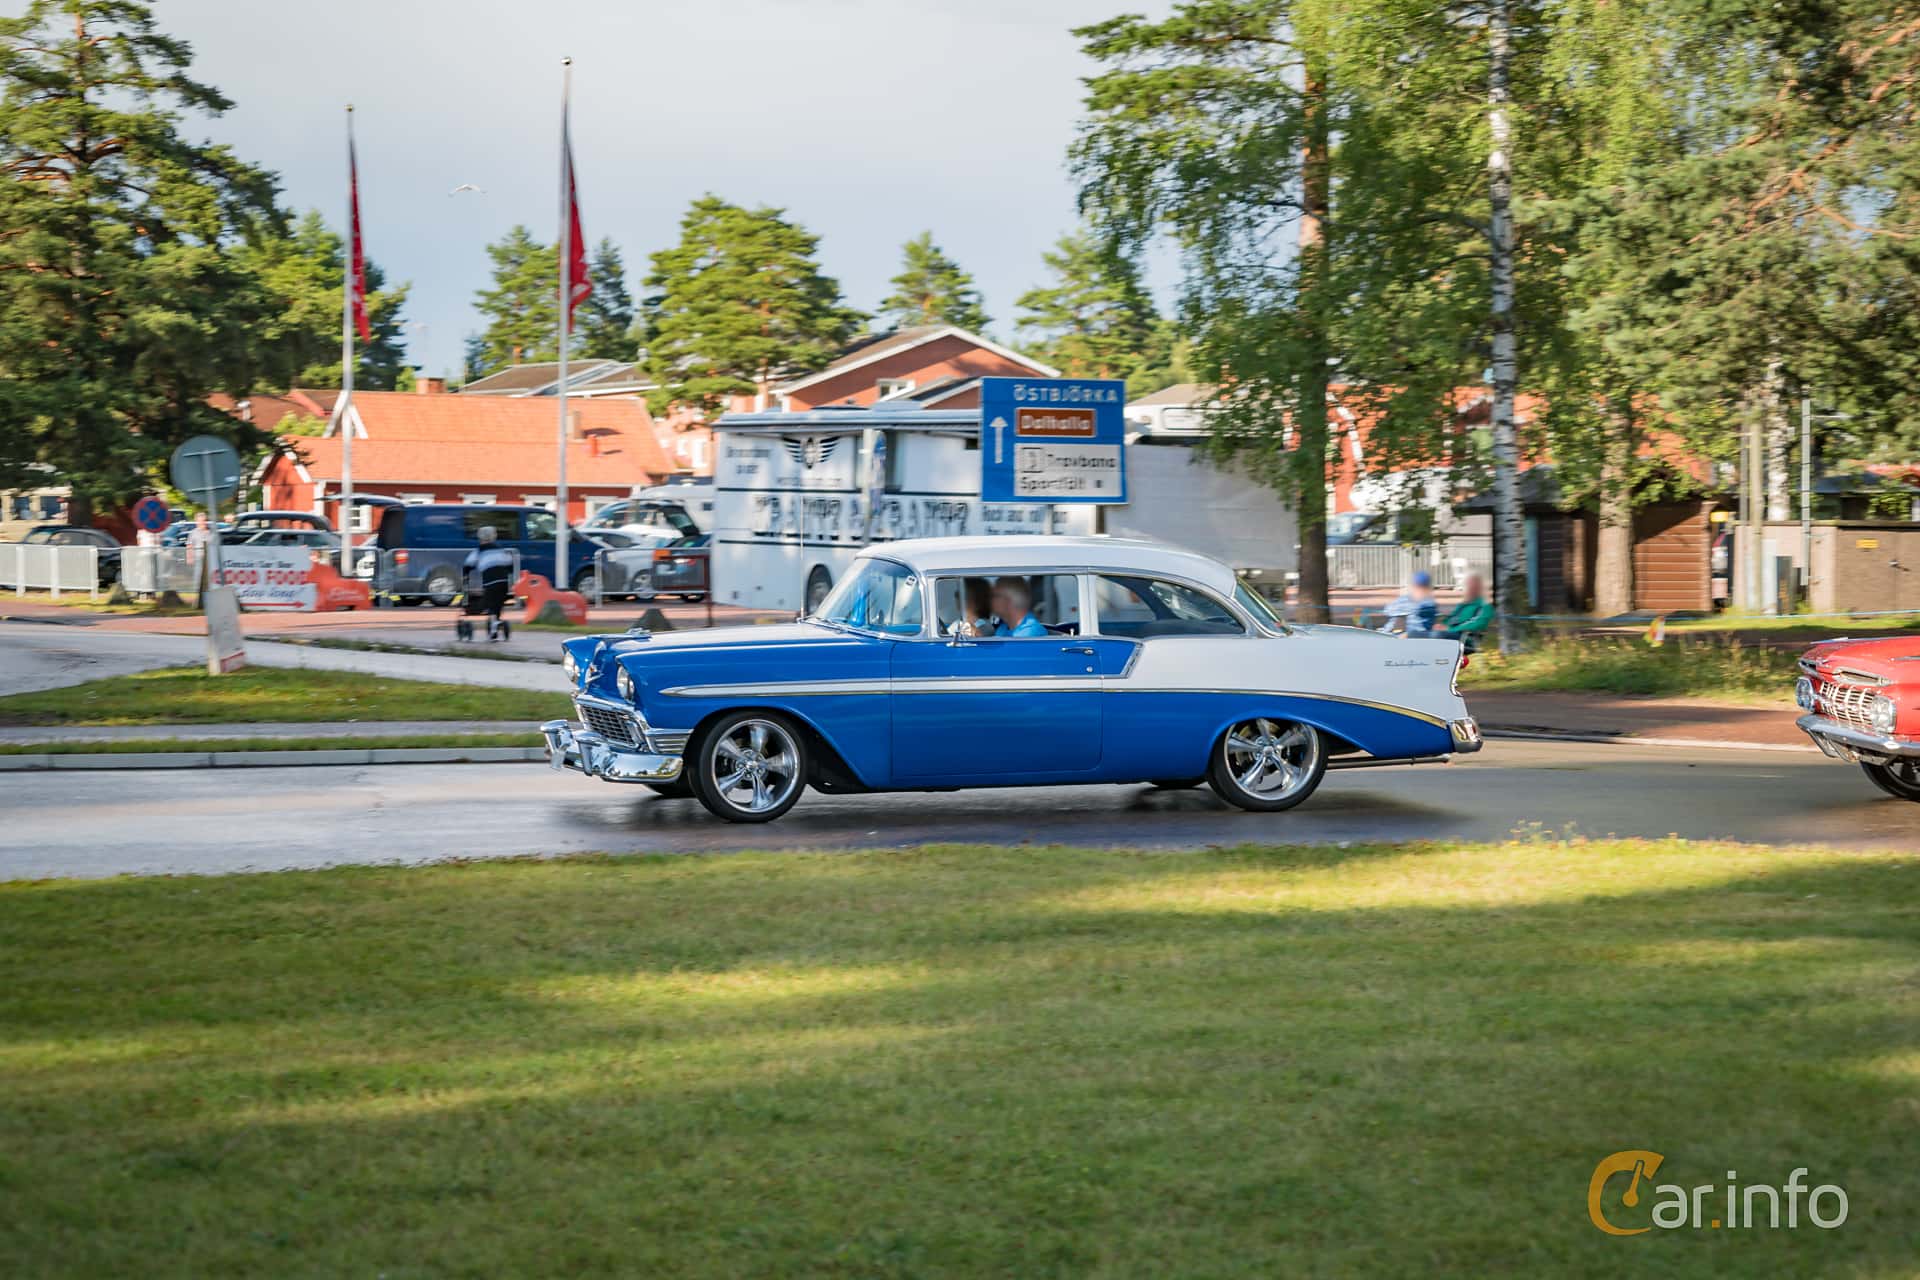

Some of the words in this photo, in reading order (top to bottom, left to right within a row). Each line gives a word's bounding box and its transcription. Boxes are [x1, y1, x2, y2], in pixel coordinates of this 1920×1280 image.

[1013, 383, 1118, 402] ÖSTBJÖRKA
[1021, 414, 1090, 430] Dalhalla
[1047, 453, 1116, 468] Travbana
[265, 569, 307, 585] FOOD
